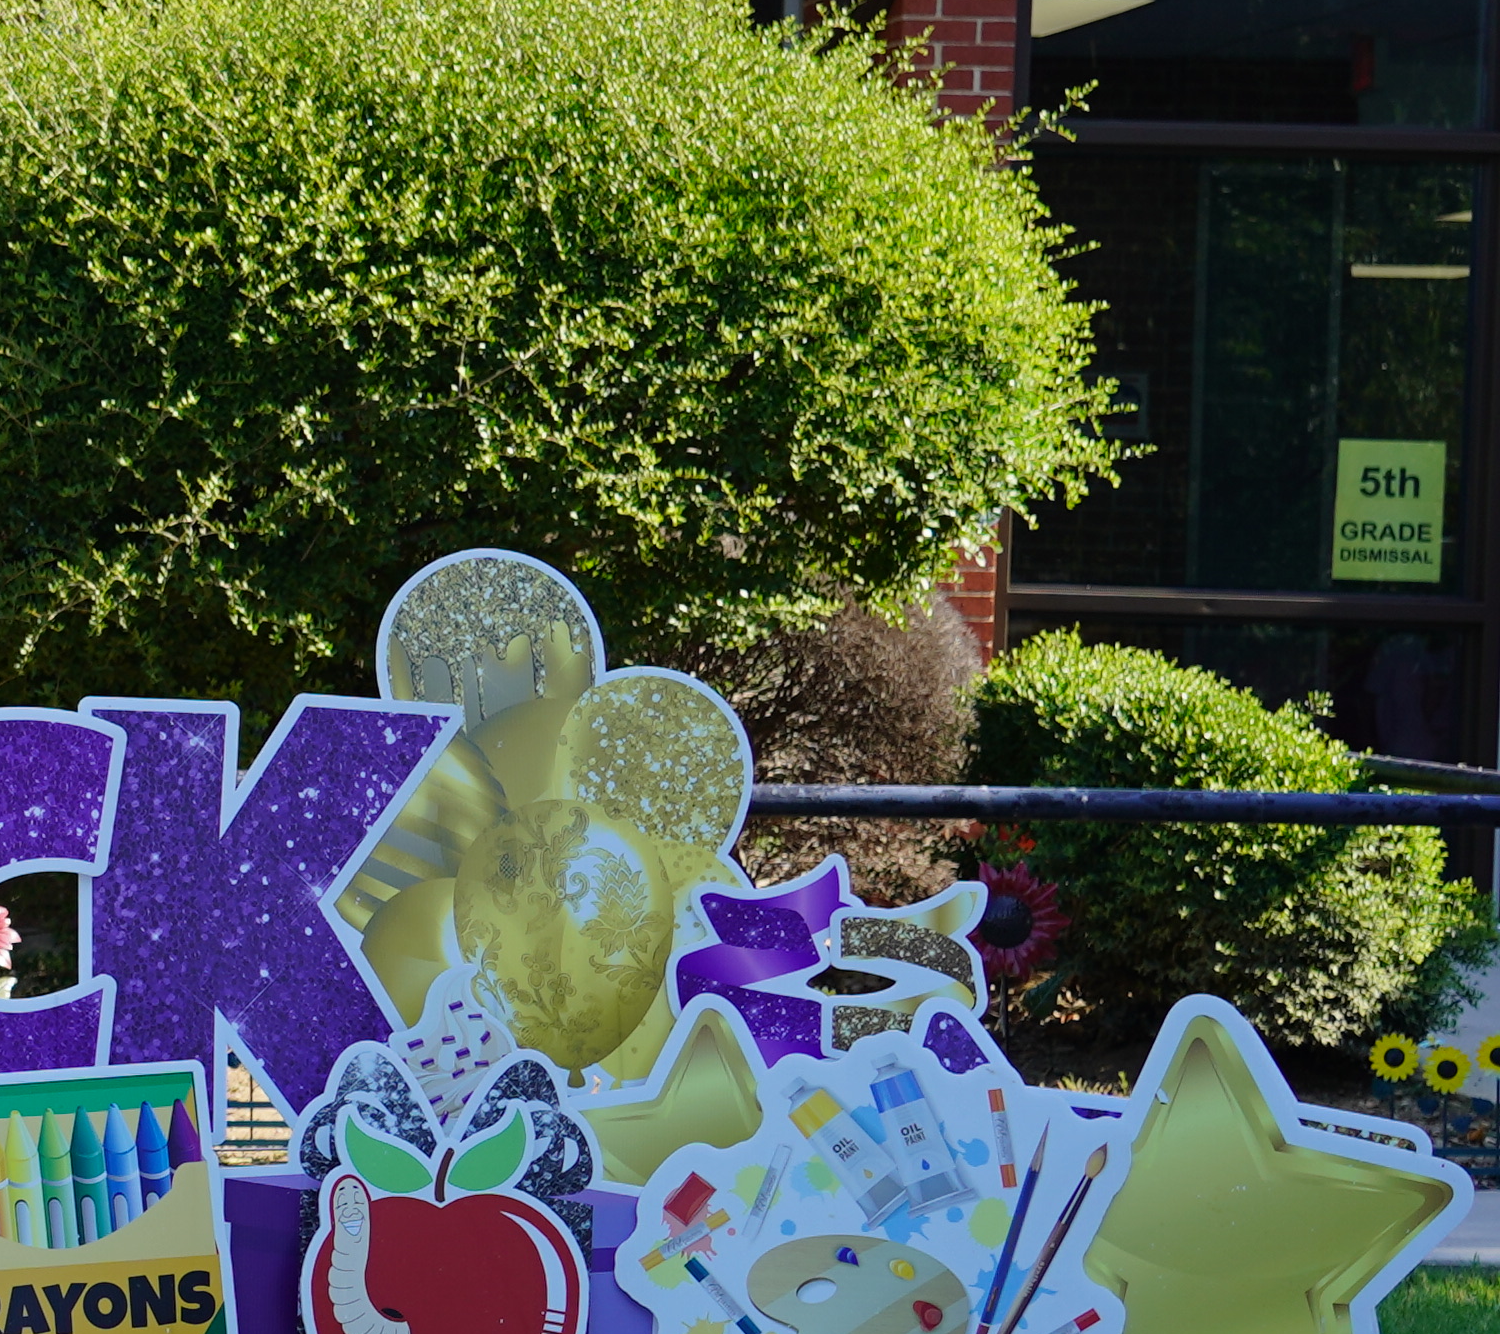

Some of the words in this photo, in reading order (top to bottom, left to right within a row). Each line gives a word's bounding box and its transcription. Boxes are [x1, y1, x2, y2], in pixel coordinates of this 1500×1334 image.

[1360, 467, 1420, 499] 5th
[1341, 520, 1433, 543] GRADE
[1340, 548, 1434, 565] DISMISSAL
[901, 1123, 922, 1137] OIL
[832, 1137, 853, 1154] OIL
[904, 1131, 926, 1147] PAINT
[838, 1142, 860, 1163] PAINT
